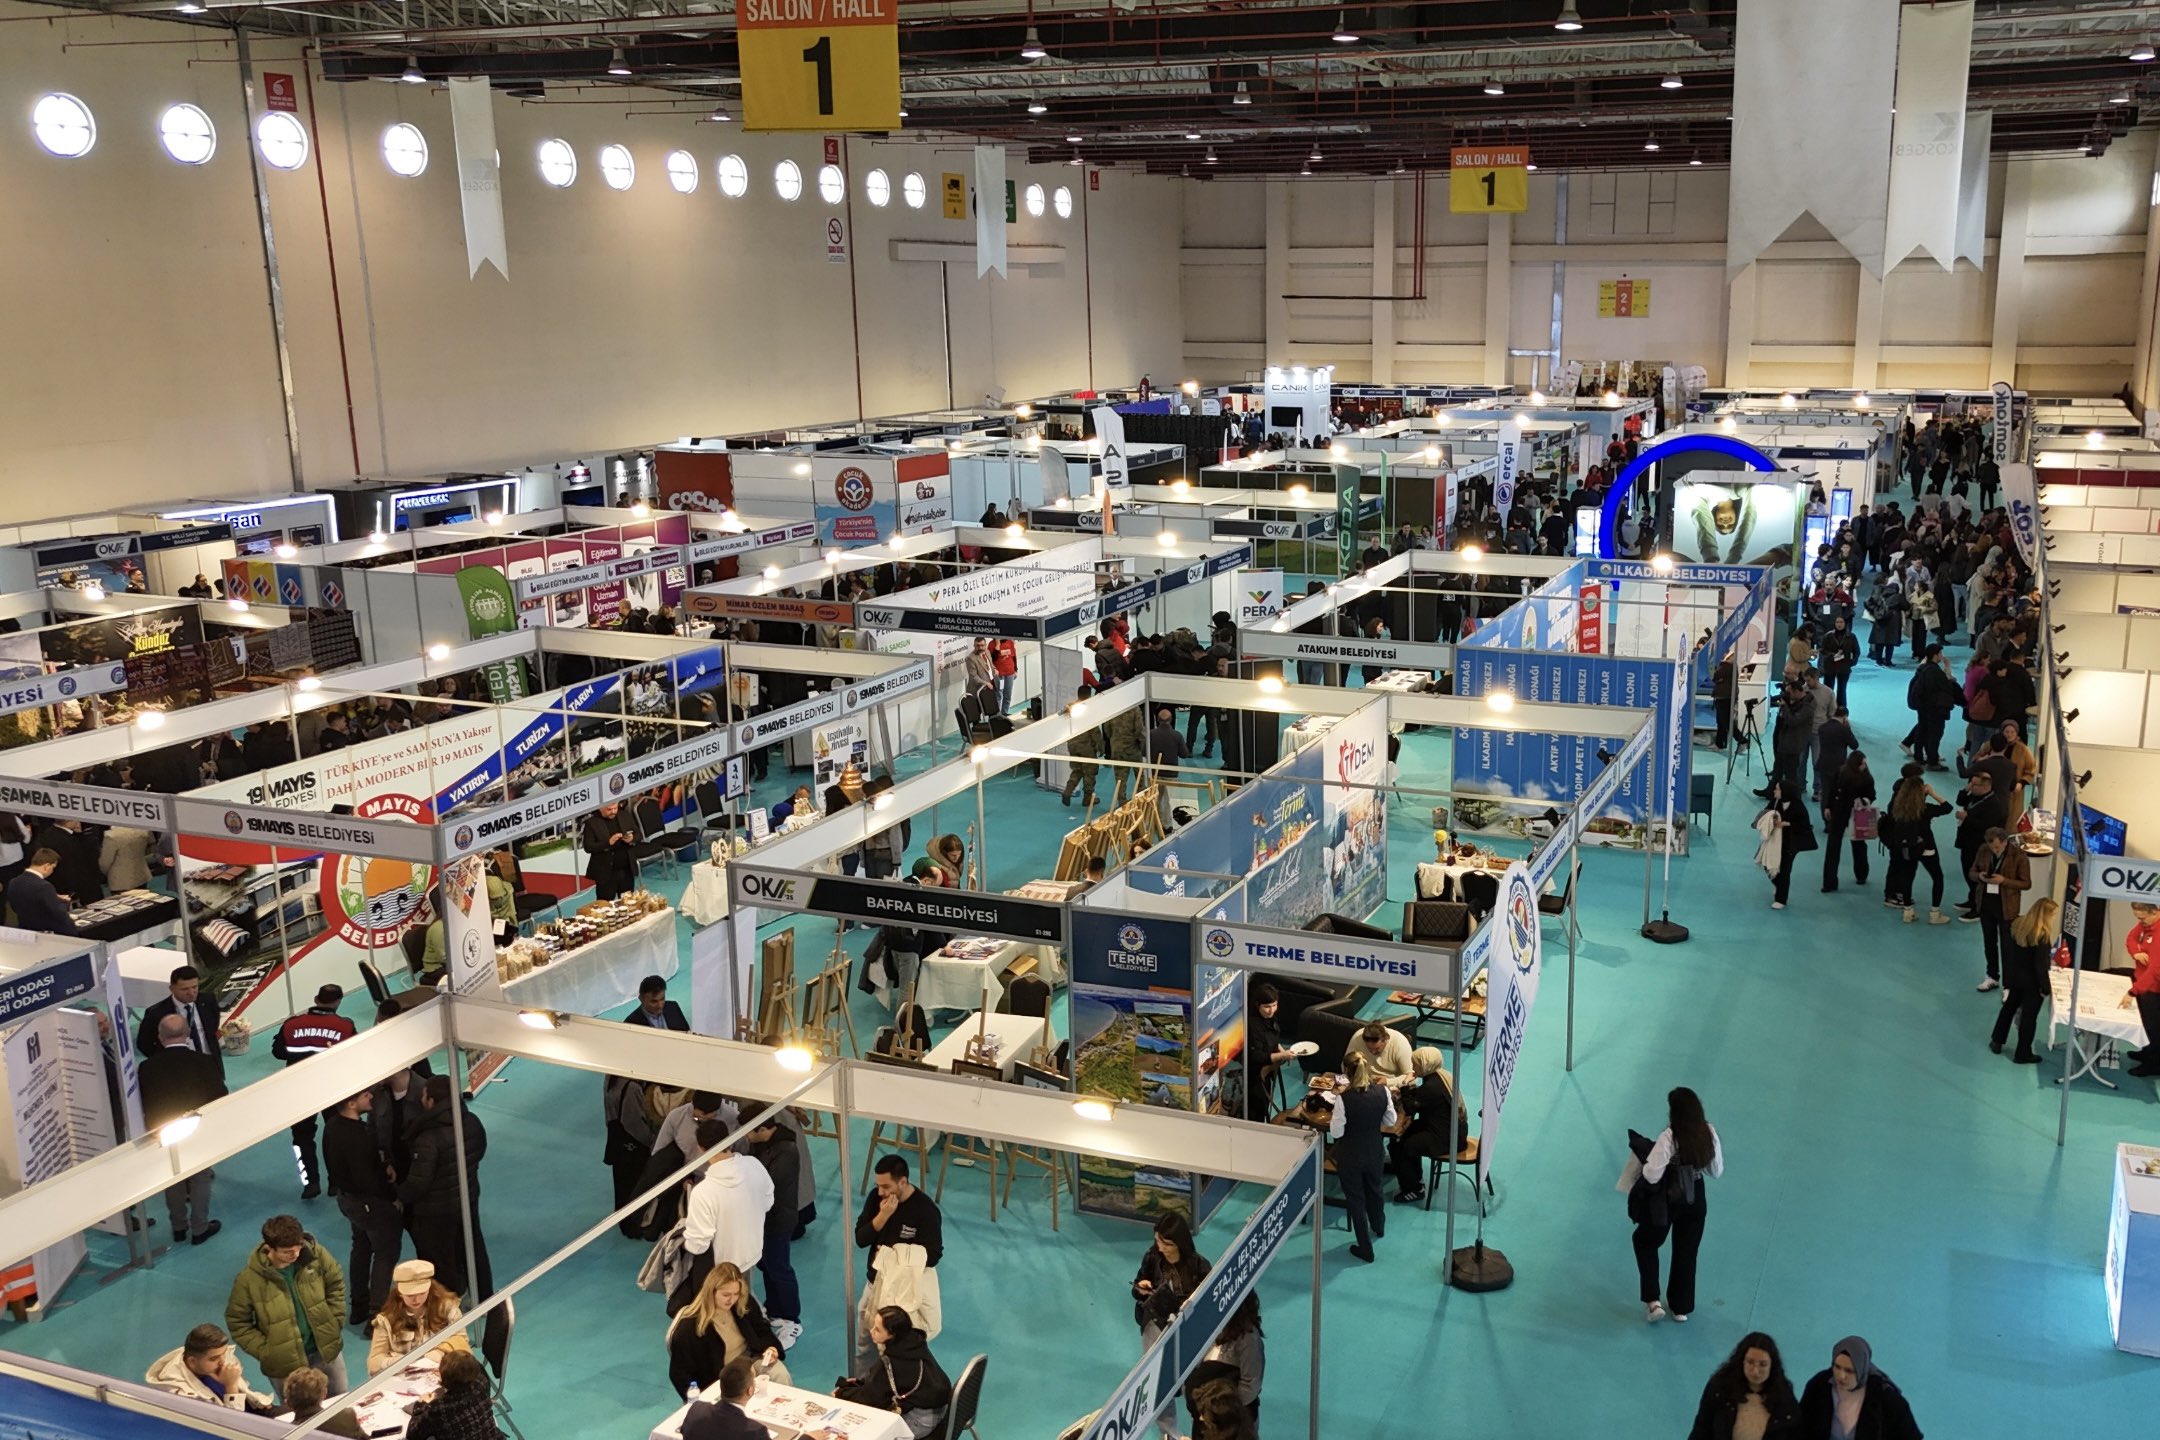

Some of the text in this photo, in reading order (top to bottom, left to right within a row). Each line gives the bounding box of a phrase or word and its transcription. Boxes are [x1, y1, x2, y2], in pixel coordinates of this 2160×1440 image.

[746, 0, 813, 21] SALON
[833, 0, 885, 18] HALL
[803, 37, 834, 115] 1
[1455, 153, 1488, 166] SALON
[1497, 153, 1522, 166] HALL
[1481, 172, 1496, 206] 1
[1621, 292, 1628, 304] 2
[1503, 442, 1514, 480] erçal
[591, 547, 618, 560] Eğitimde
[942, 587, 961, 599] PERA
[962, 579, 979, 592] ÖZEL
[981, 572, 1003, 586] EĞİTİM
[1671, 568, 1750, 582] BELEDİYESİ
[752, 601, 778, 611] ÖZLEM
[964, 595, 976, 608] DİL
[978, 588, 1011, 605] KONUŞMA
[1022, 578, 1044, 594] ÇOCUK
[938, 616, 997, 626] PERA ÖZEL EĞİTİM
[1242, 606, 1277, 618] PERA
[934, 623, 1001, 634] KURUMLARI SAMSUN
[1297, 643, 1397, 660] ATAKUM BELEDİYESİ
[886, 669, 925, 691] BELEDİYESİ
[1460, 660, 1471, 696] DURAĞI
[1529, 665, 1539, 701] KONAĞI
[1650, 673, 1660, 699] ADIM
[568, 684, 594, 712] TARIM
[789, 701, 834, 727] BELEDİYESİ
[393, 750, 405, 760] ve
[461, 724, 493, 742] Yakışır
[515, 722, 551, 756] TURİZM
[1482, 731, 1491, 769] İLKADIM
[666, 741, 721, 770] BELEDİYESİ
[1575, 743, 1584, 771] AFET
[325, 777, 365, 800] DAHA
[364, 763, 416, 788] MODERN
[440, 752, 451, 767] 19
[451, 743, 484, 761] MAYIS
[449, 769, 490, 803] YATIRIM
[58, 793, 161, 821] BELEDİYESİ
[366, 798, 421, 817] MAYIS
[525, 787, 591, 822] BELEDİYESİ
[298, 823, 375, 844] BELEDİYESİ
[866, 896, 999, 924] BAFRA BELEDİYESİ
[1111, 953, 1155, 967] TERME
[1245, 941, 1417, 977] TERME BELEDİYESİ
[1472, 936, 1491, 962] TERME
[1115, 963, 1150, 972] BELEDİYESİ
[17, 974, 55, 995] ODASI
[13, 989, 50, 1009] ODASI
[293, 1026, 342, 1041] JANDARMA
[1491, 984, 1521, 1090] TERME
[1213, 1266, 1232, 1302] STAJ
[1238, 1232, 1258, 1268] IELTS
[1263, 1193, 1288, 1234] EDUGO
[1219, 1216, 1284, 1312] ONLINE İNGİLİZCE
